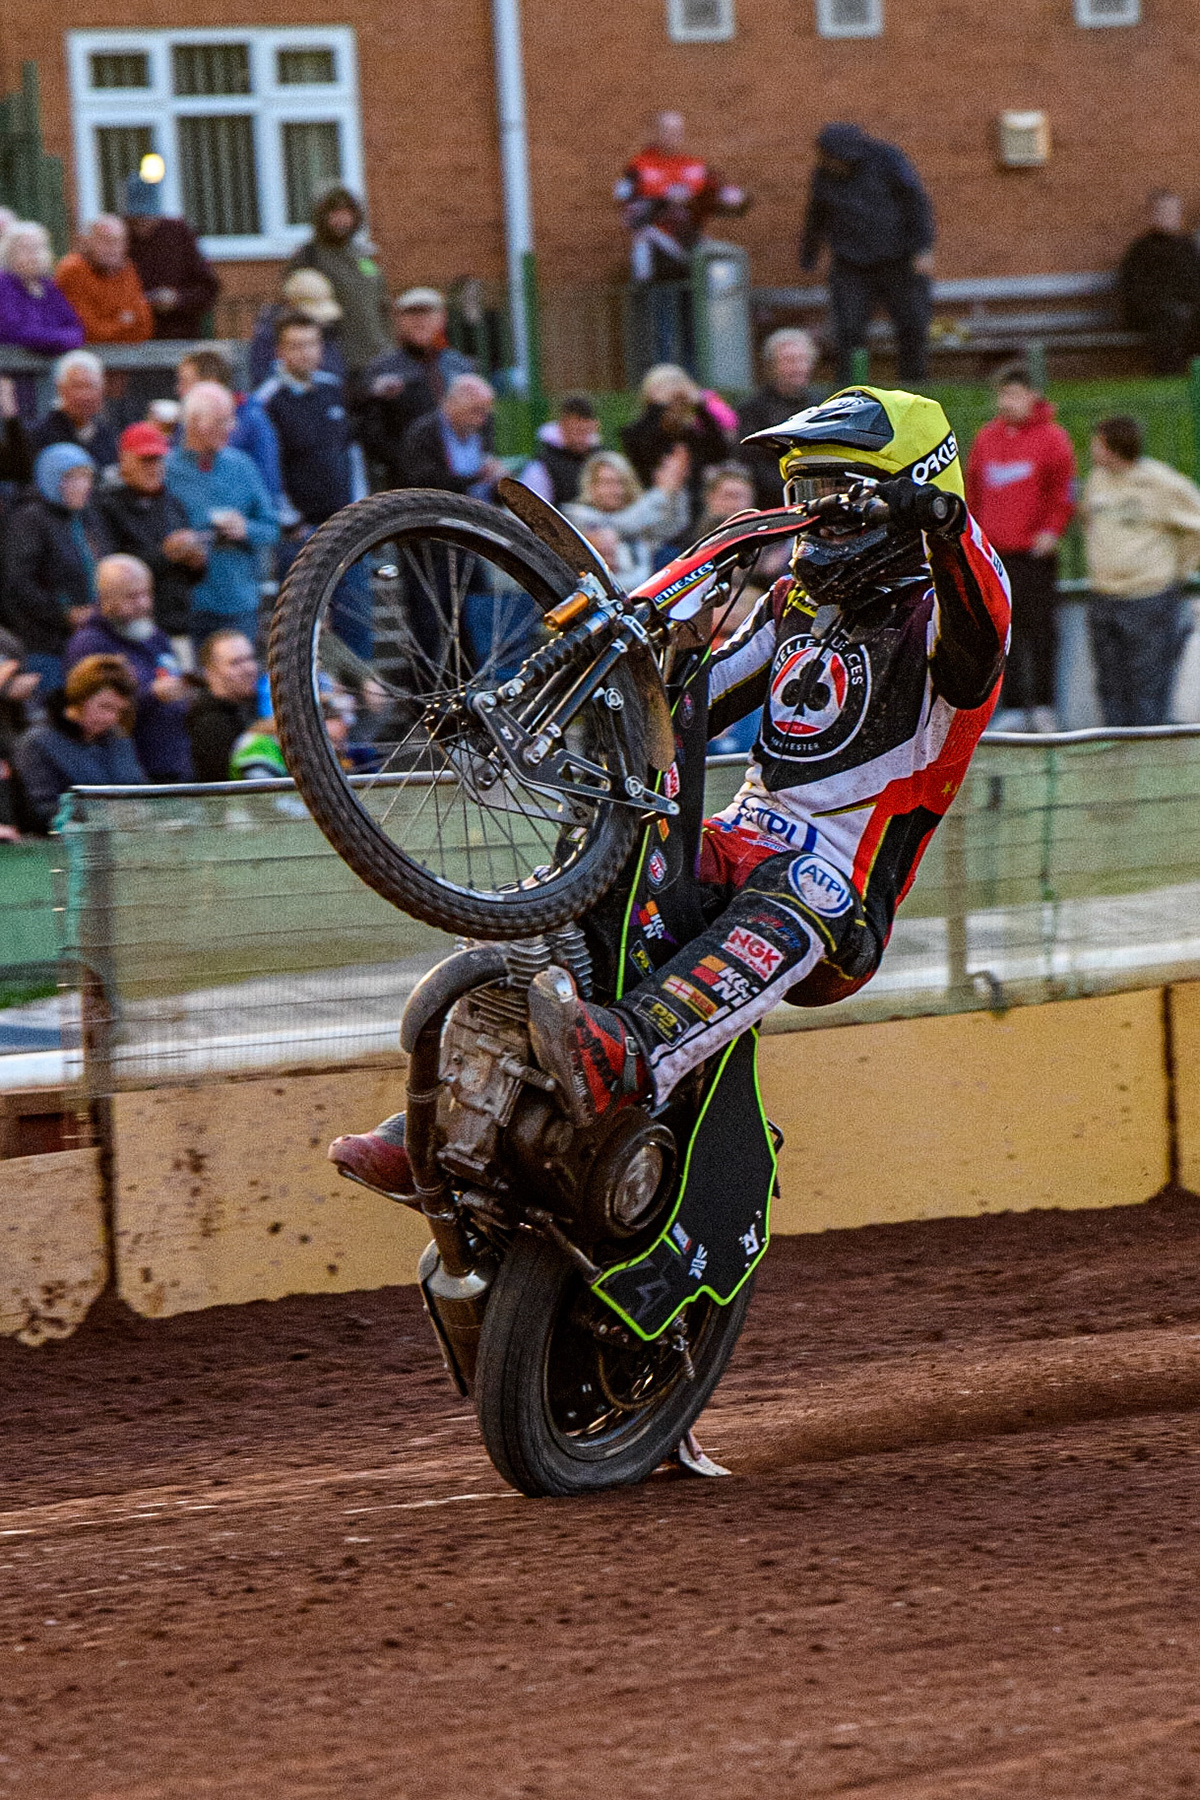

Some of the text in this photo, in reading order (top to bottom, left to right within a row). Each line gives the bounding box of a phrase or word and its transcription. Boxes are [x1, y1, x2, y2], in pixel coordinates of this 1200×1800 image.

[911, 433, 958, 485] OAKLE
[842, 651, 863, 686] CES
[800, 864, 847, 903] ATPI
[728, 929, 781, 973] NGK
